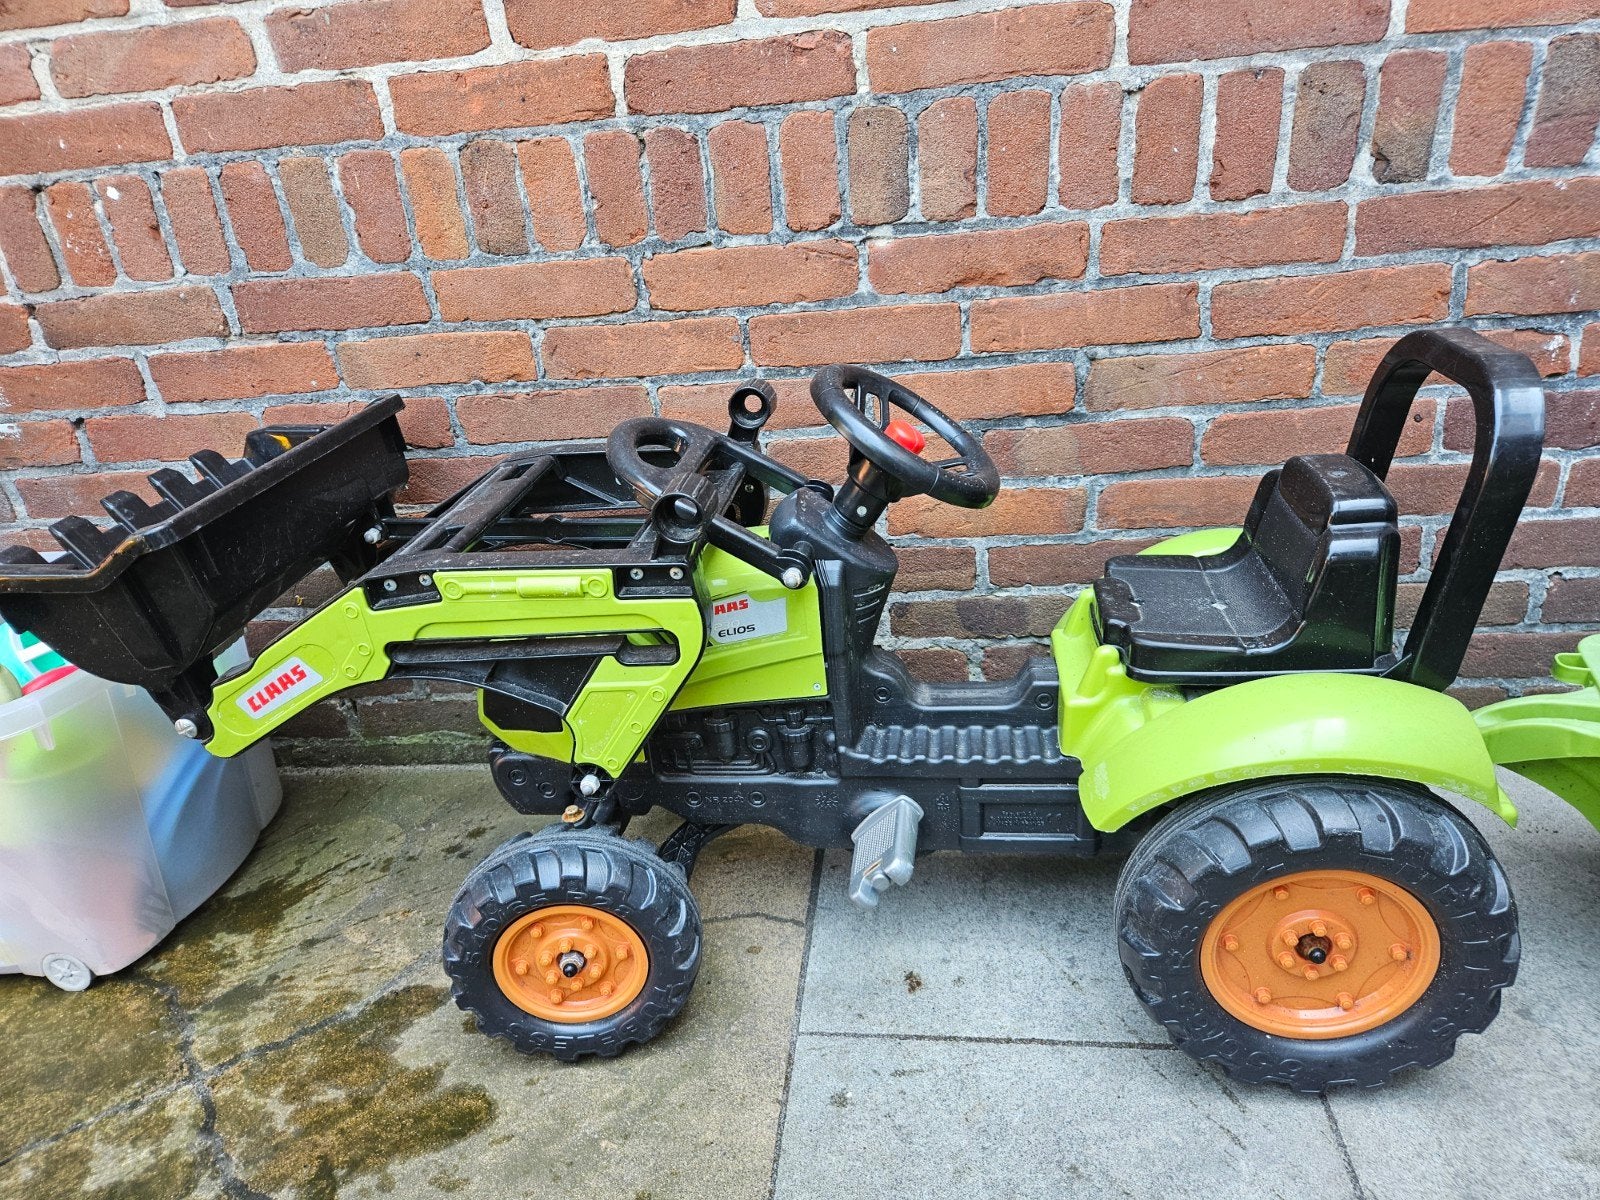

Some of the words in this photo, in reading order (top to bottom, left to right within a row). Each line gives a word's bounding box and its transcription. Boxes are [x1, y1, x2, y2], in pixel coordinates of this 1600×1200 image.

[714, 599, 749, 615] AAS
[718, 624, 755, 637] ELIOS
[247, 664, 307, 712] CLAAS
